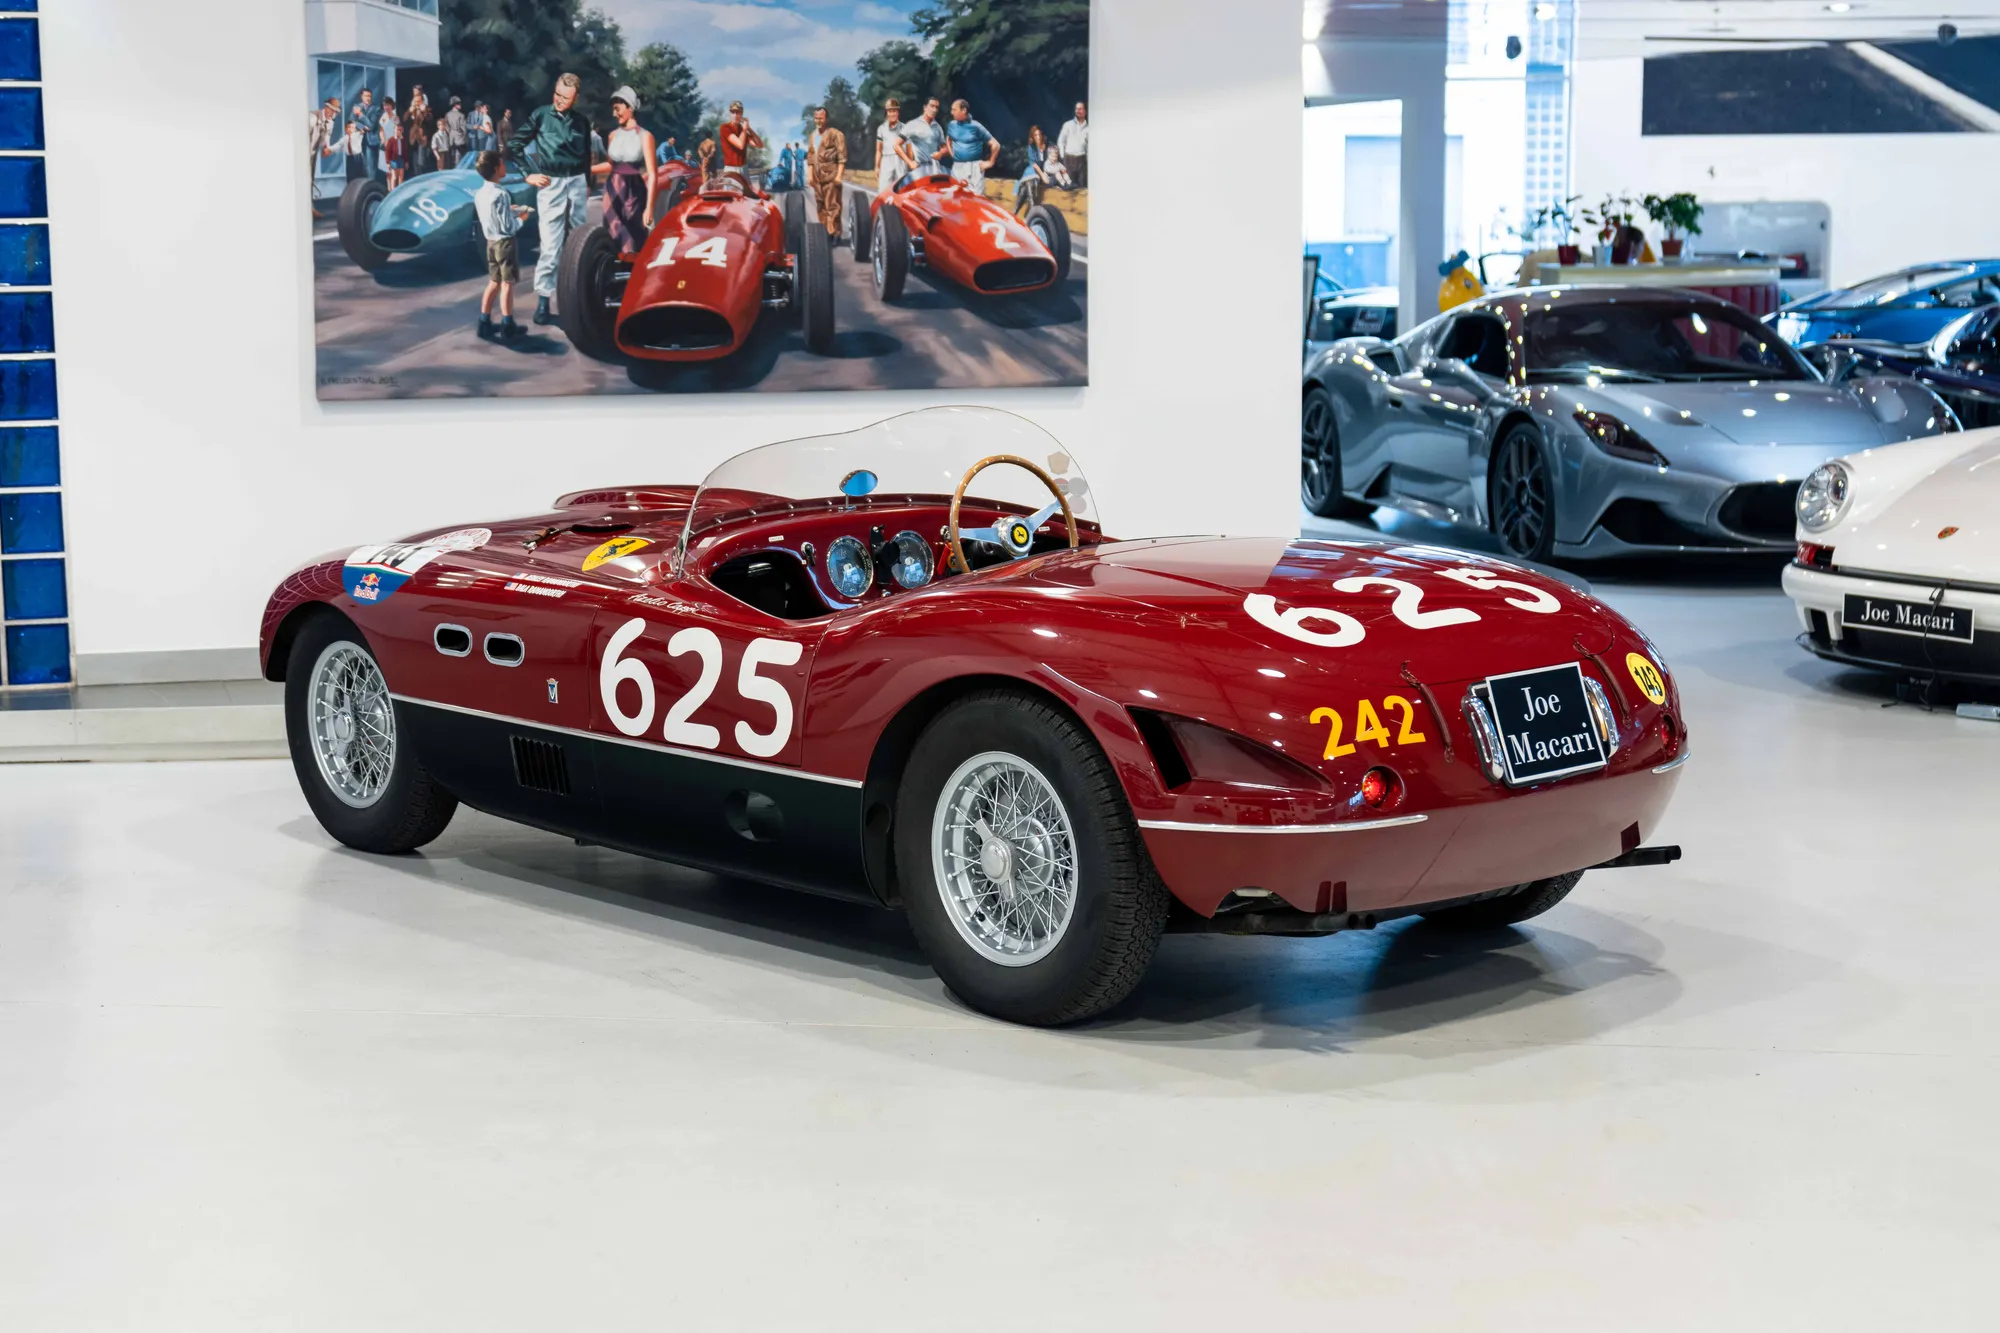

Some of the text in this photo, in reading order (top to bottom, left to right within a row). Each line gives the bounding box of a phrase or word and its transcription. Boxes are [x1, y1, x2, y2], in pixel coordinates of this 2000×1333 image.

[409, 198, 448, 225] 18
[647, 236, 727, 269] 14
[981, 222, 1019, 249] 2
[1243, 567, 1561, 647] 625
[1861, 600, 1955, 631] Joe Macari
[600, 617, 803, 757] 625
[1634, 665, 1663, 697] 143
[1520, 686, 1561, 722] Joe
[1309, 695, 1426, 760] 242
[1508, 722, 1595, 765] Macari
